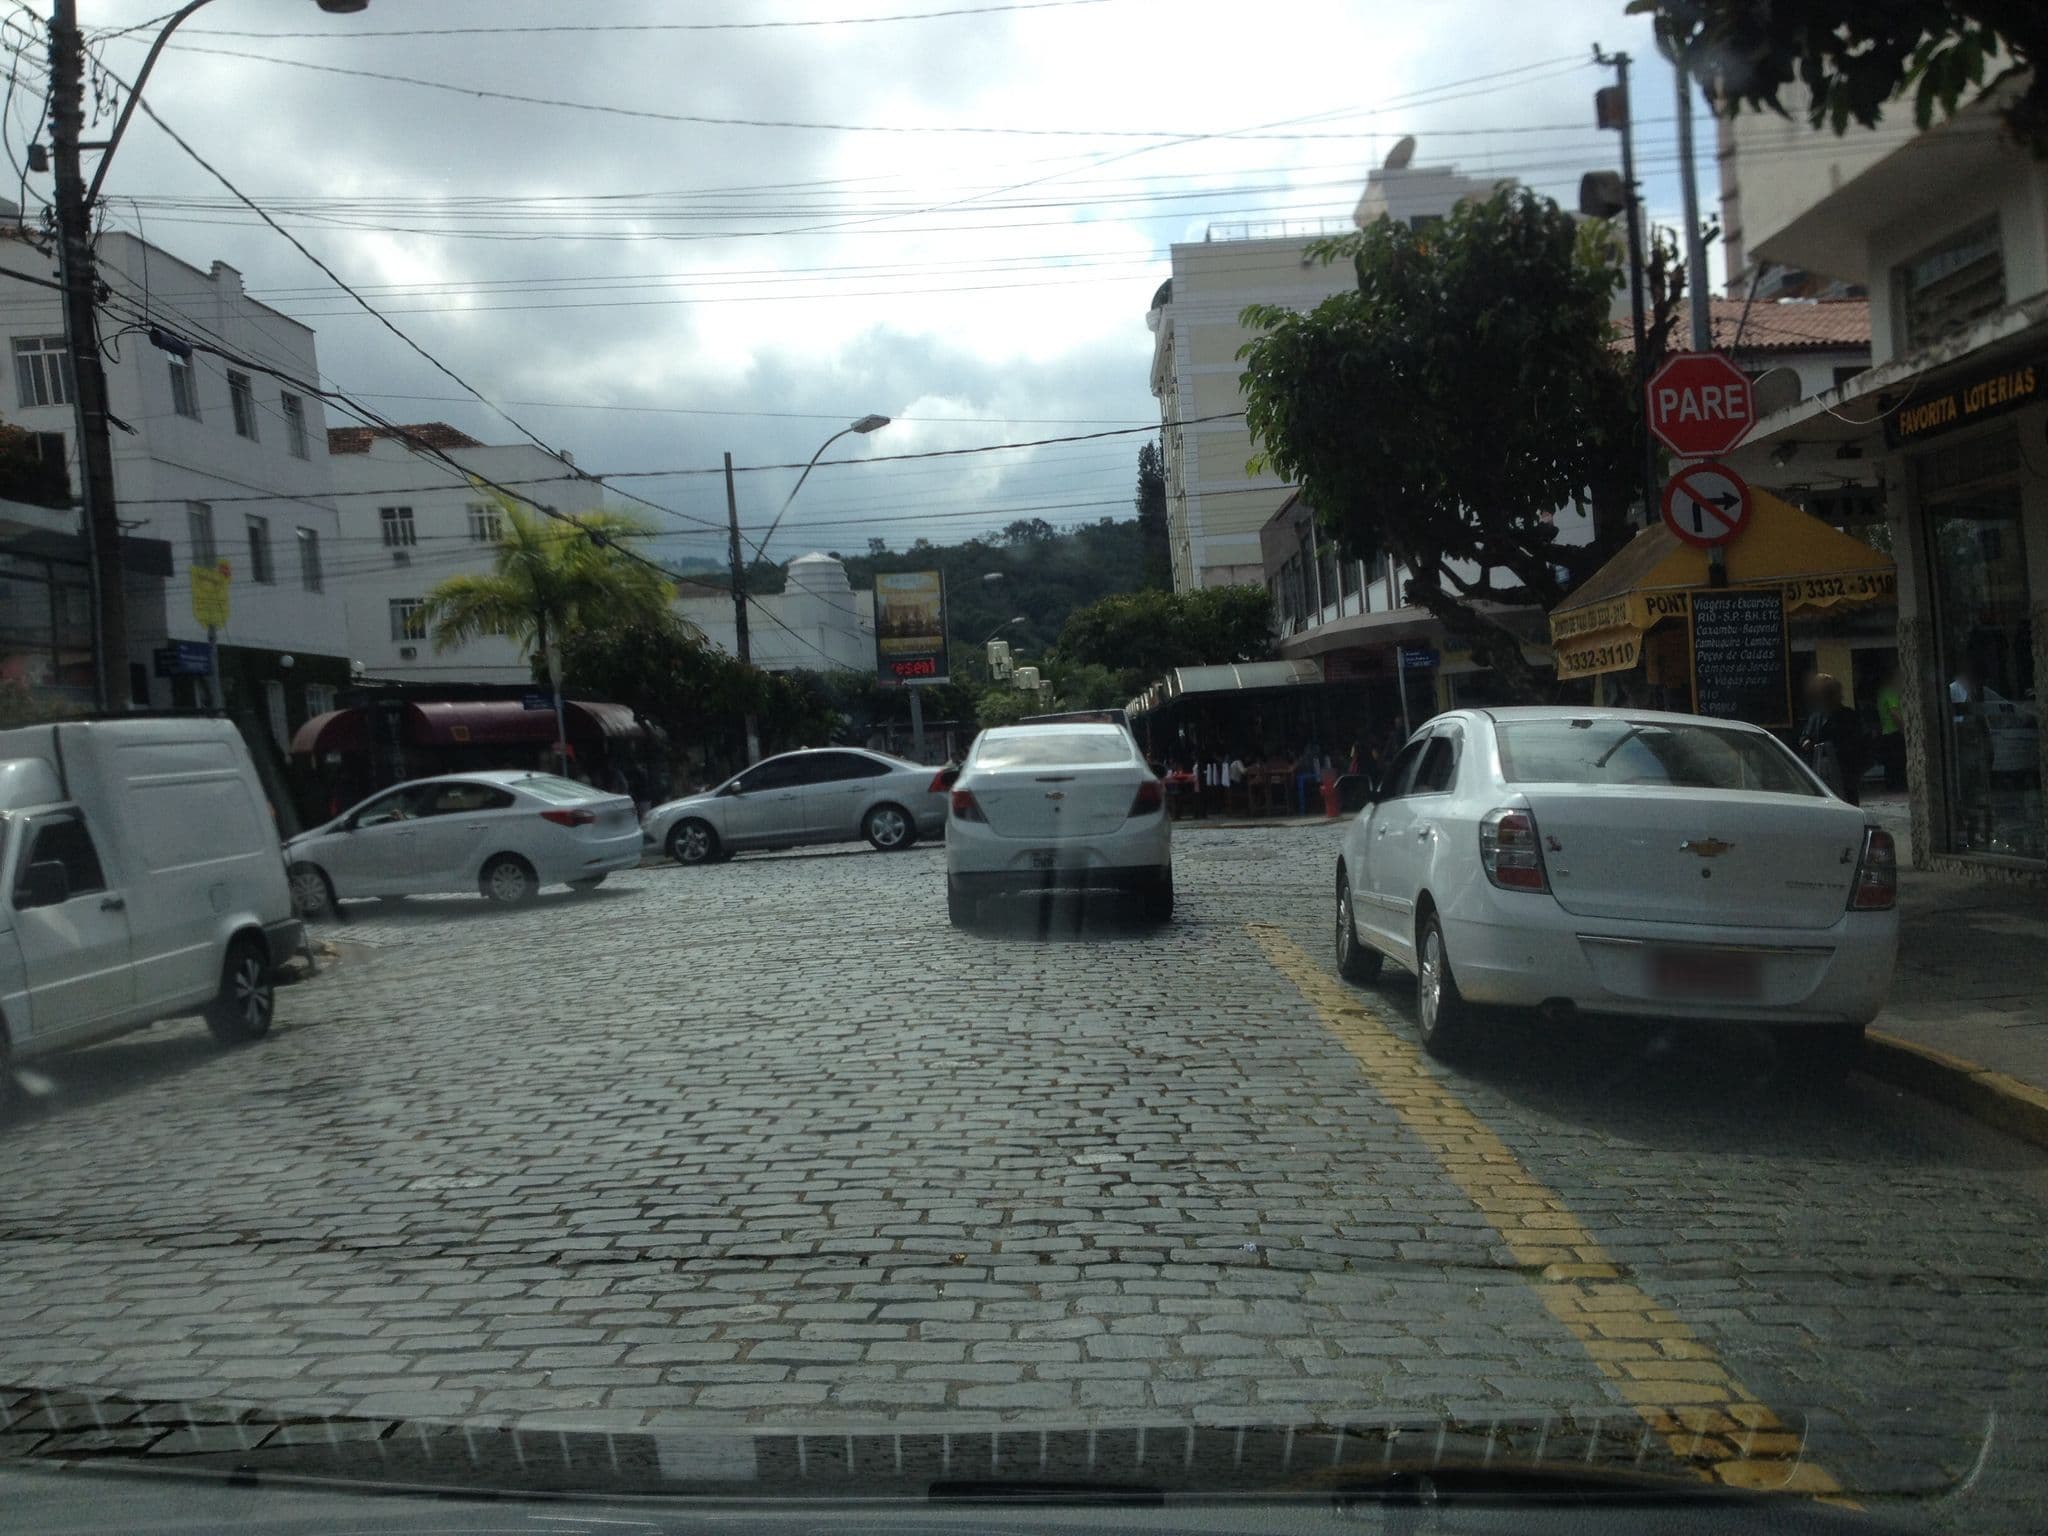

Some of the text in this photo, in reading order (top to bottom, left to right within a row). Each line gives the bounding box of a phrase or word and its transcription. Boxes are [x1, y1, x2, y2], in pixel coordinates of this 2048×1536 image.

[1659, 384, 1745, 423] PARE
[1898, 367, 2036, 435] FAVORITA LOTERIAS
[1807, 578, 1846, 600] 3332
[1857, 575, 1897, 594] 3110
[1697, 612, 1716, 623] RIO
